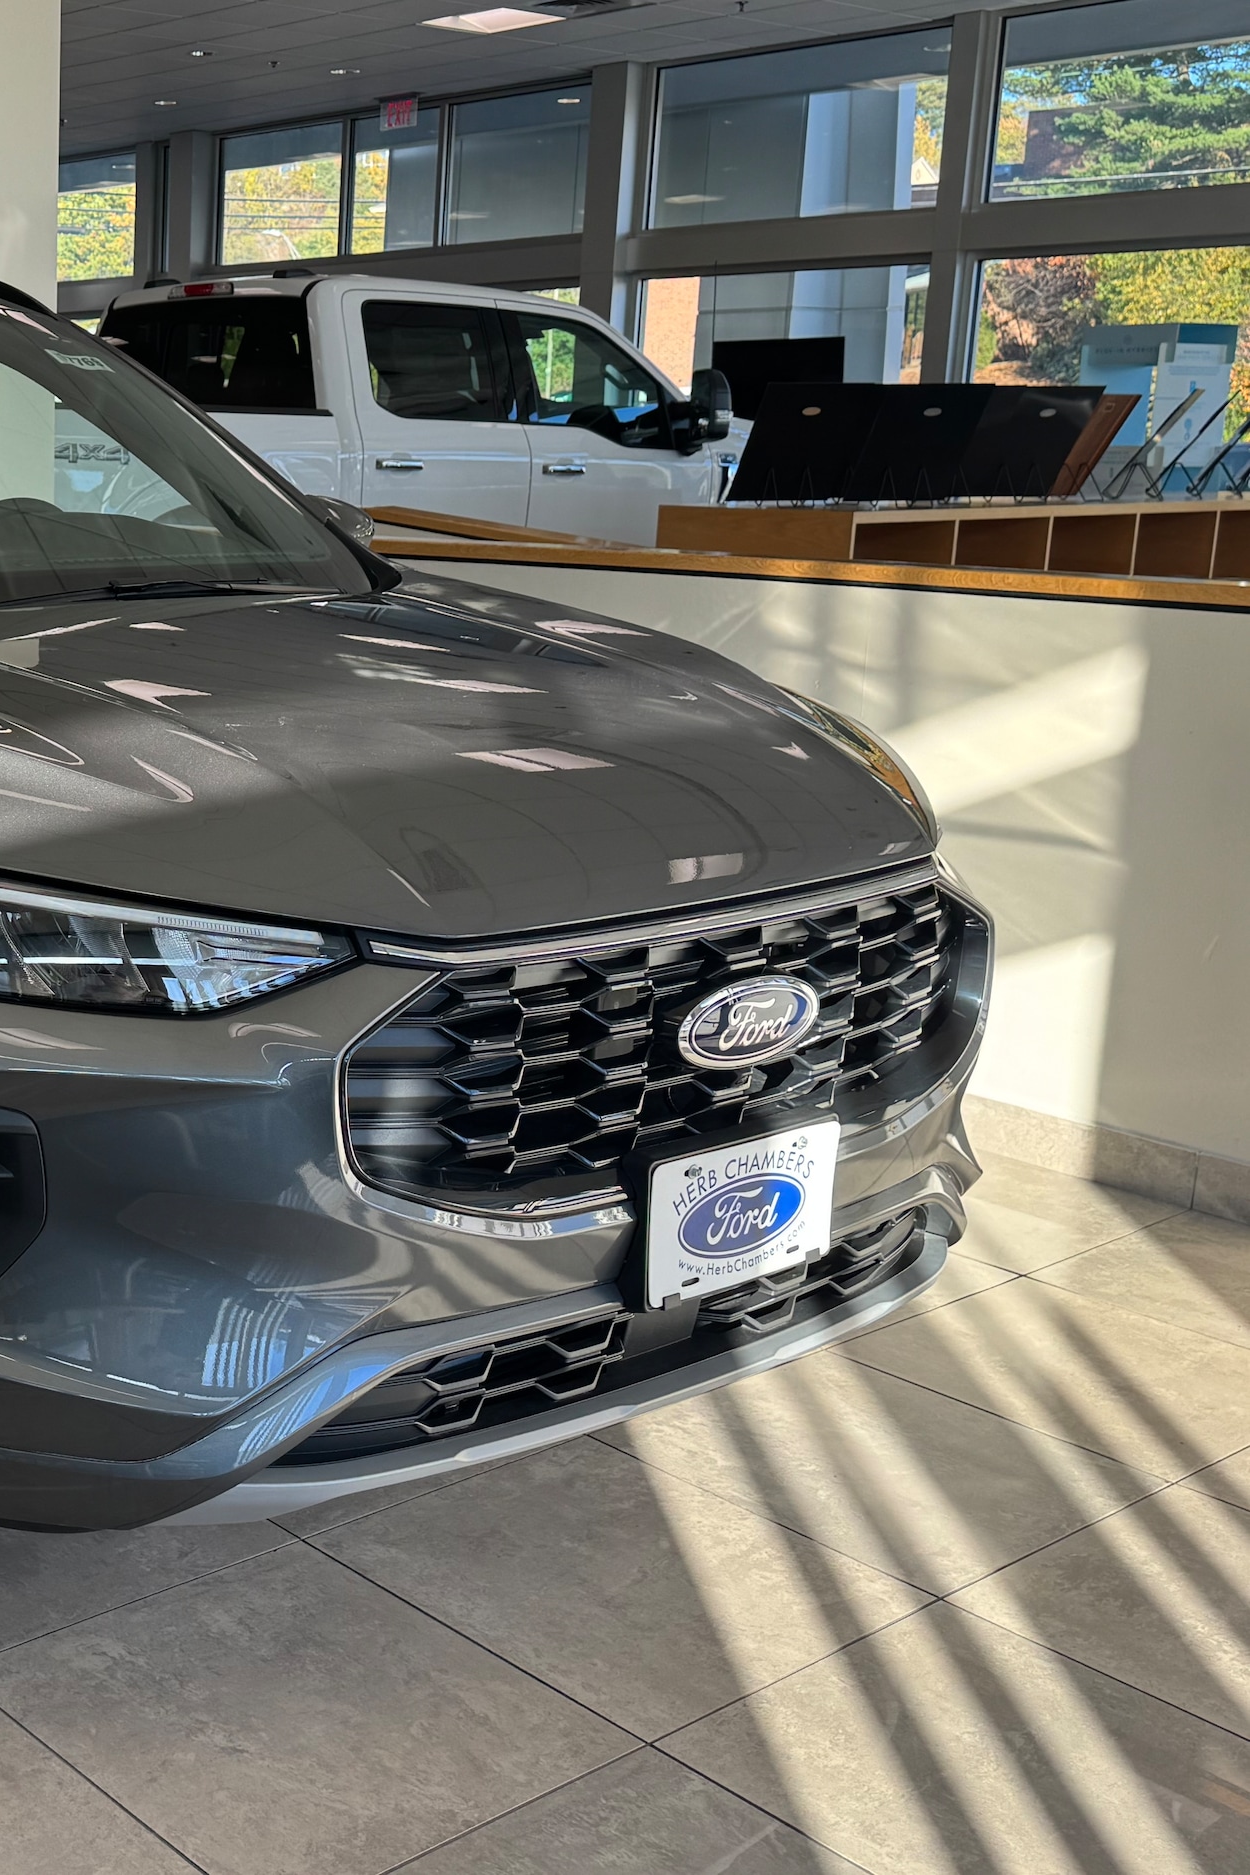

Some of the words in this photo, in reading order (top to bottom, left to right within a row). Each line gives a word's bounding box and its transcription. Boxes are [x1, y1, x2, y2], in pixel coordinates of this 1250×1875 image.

[718, 998, 793, 1051] Ford
[672, 1169, 718, 1217] HERB
[724, 1150, 815, 1179] CHAMBERS
[707, 1186, 781, 1246] Ford
[678, 1219, 806, 1276] www.HerbChamberscom
